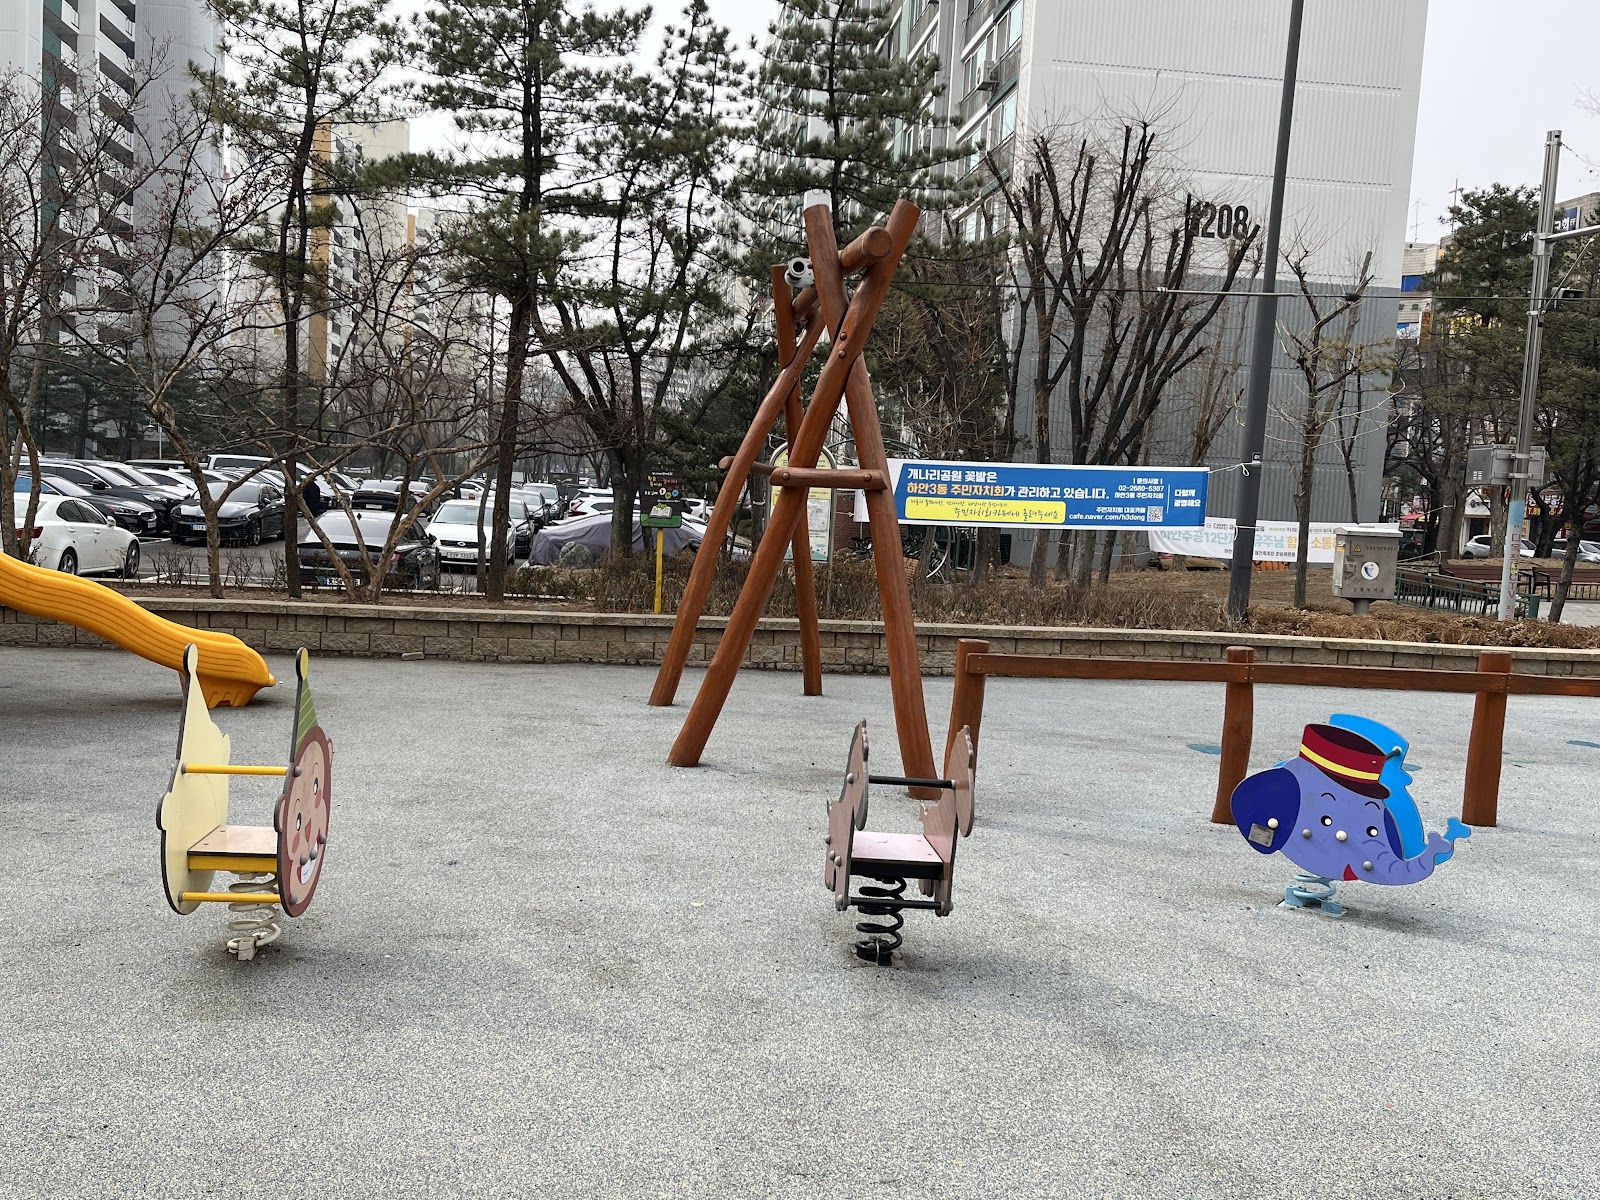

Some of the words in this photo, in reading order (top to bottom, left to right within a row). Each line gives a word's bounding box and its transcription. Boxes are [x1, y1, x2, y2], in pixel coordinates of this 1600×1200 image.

[907, 468, 962, 482] 개나리공원
[906, 482, 948, 495] 하안3동
[950, 483, 1016, 497] 주민자치회가
[1017, 486, 1061, 498] 관리하고
[1063, 487, 1110, 499] 있습니다.
[1174, 489, 1196, 497] 다함께
[1023, 508, 1059, 522] 올려주세요
[1069, 513, 1145, 522] cafe.naver.com/h3dong
[1286, 534, 1298, 549] 함
